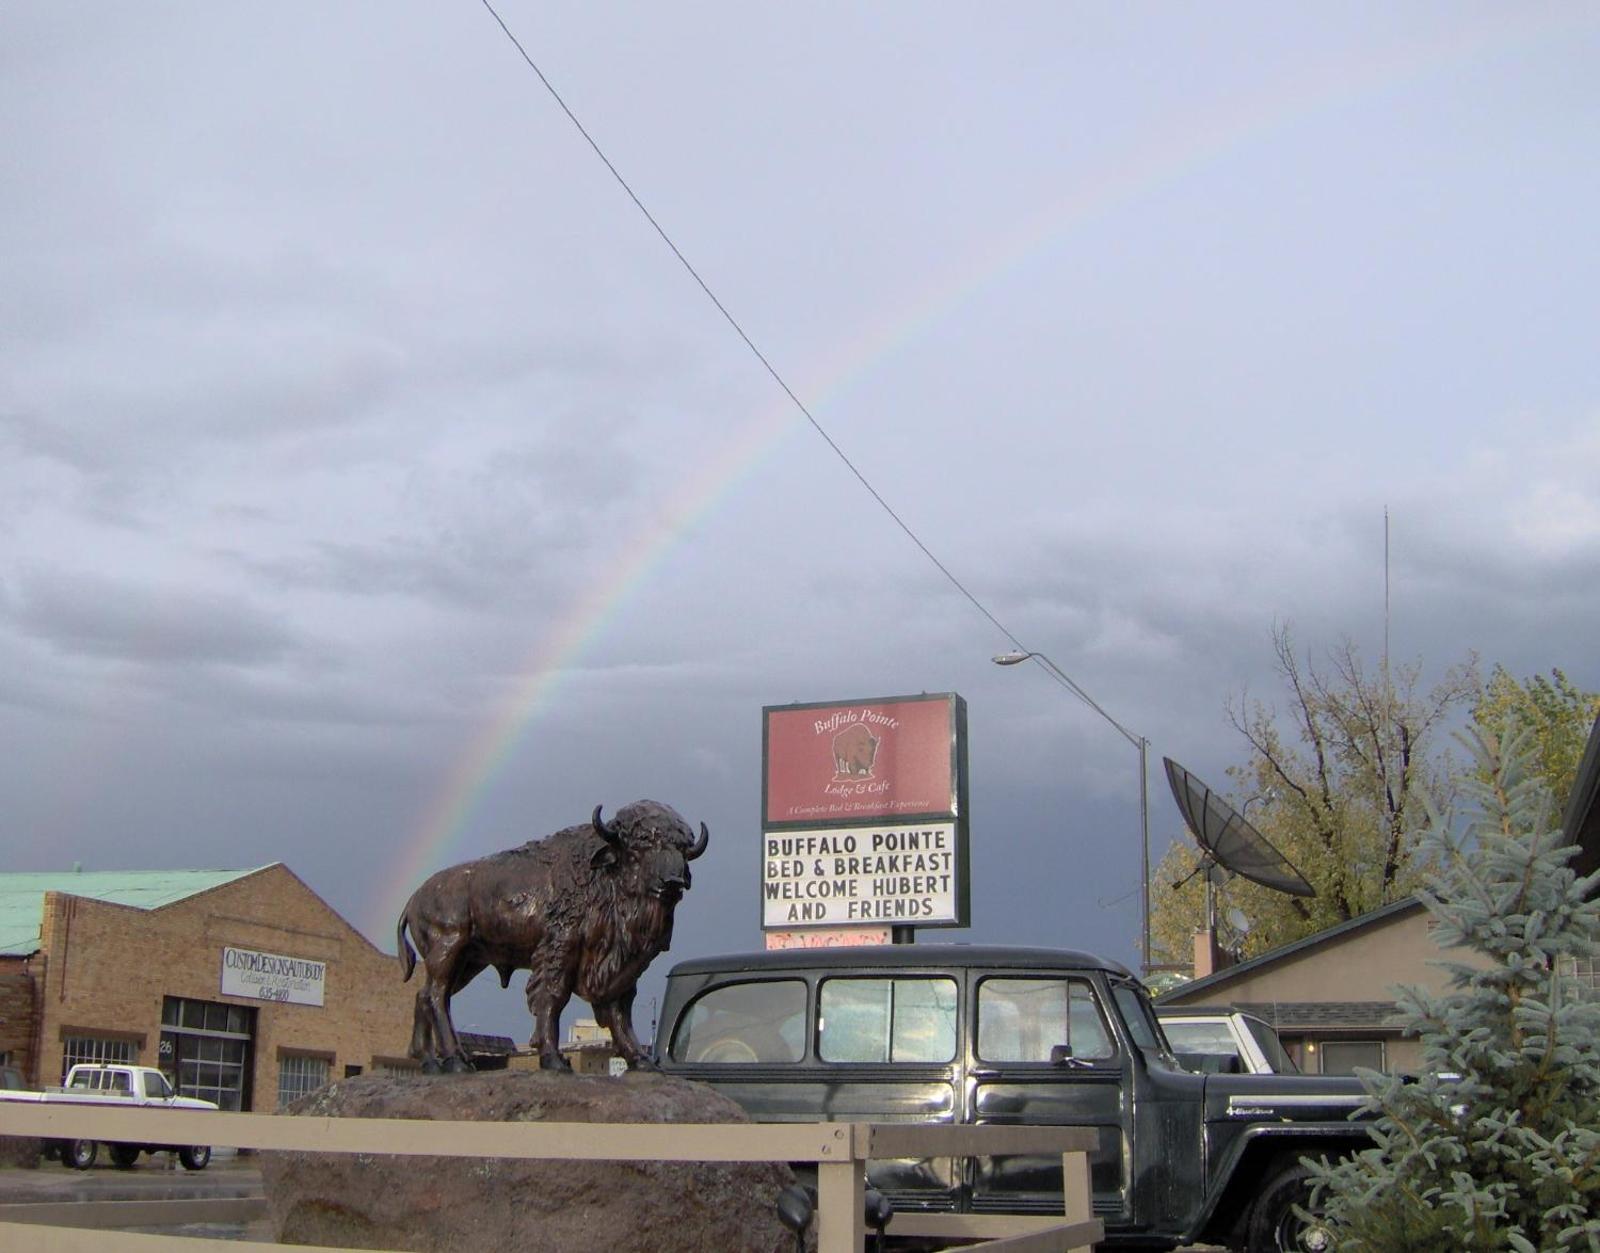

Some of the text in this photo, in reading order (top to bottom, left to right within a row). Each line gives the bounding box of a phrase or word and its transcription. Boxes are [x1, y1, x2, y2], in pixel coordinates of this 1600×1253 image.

[813, 709, 899, 735] Buffalo Pointe
[824, 783, 854, 798] Lodge
[855, 784, 865, 794] &
[767, 831, 945, 857] BUFFALO POINTE
[767, 852, 952, 878] BED & BREAKFAST
[765, 875, 950, 900] WELCOME HUBERT
[788, 897, 933, 920] AND FRIENDS
[160, 1040, 172, 1054] 26
